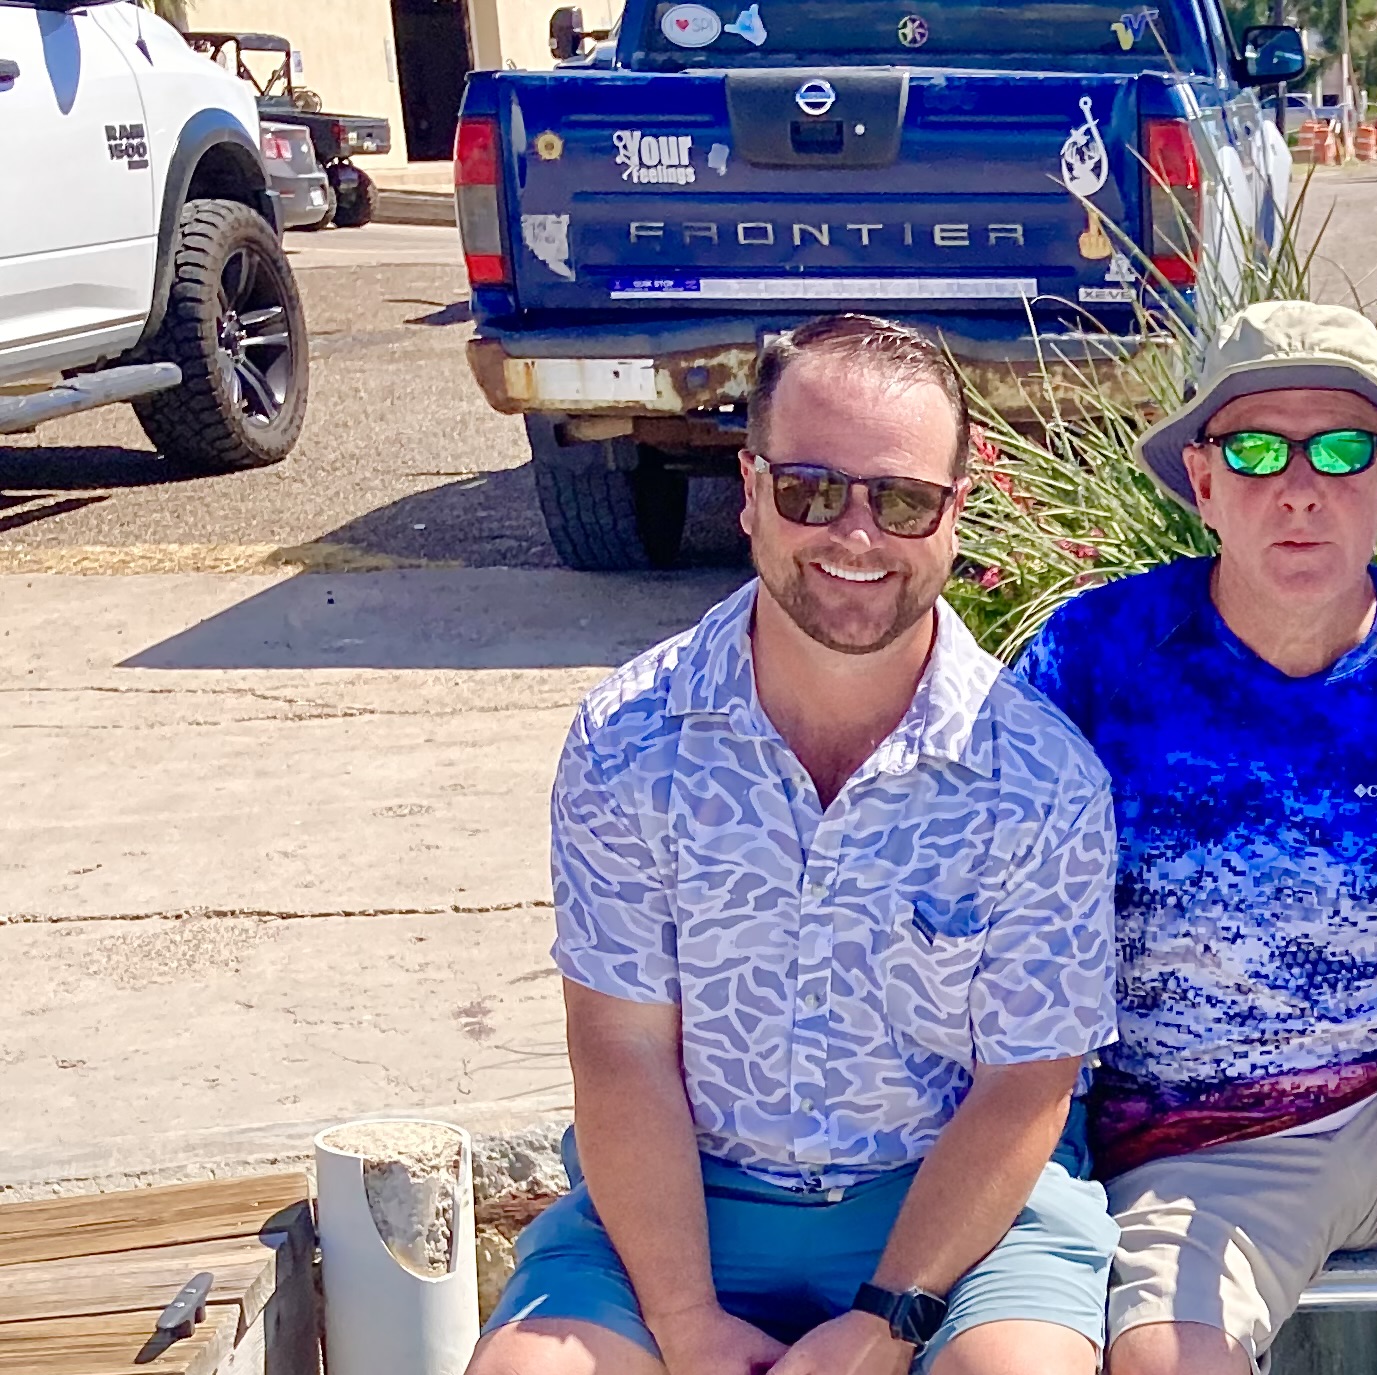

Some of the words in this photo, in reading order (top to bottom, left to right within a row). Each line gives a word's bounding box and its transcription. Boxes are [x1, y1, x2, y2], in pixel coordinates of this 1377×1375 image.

[104, 123, 145, 142] RAM
[108, 141, 148, 161] 1500
[620, 129, 692, 167] Your
[632, 165, 696, 185] feelings
[629, 221, 1025, 247] FRONTIER
